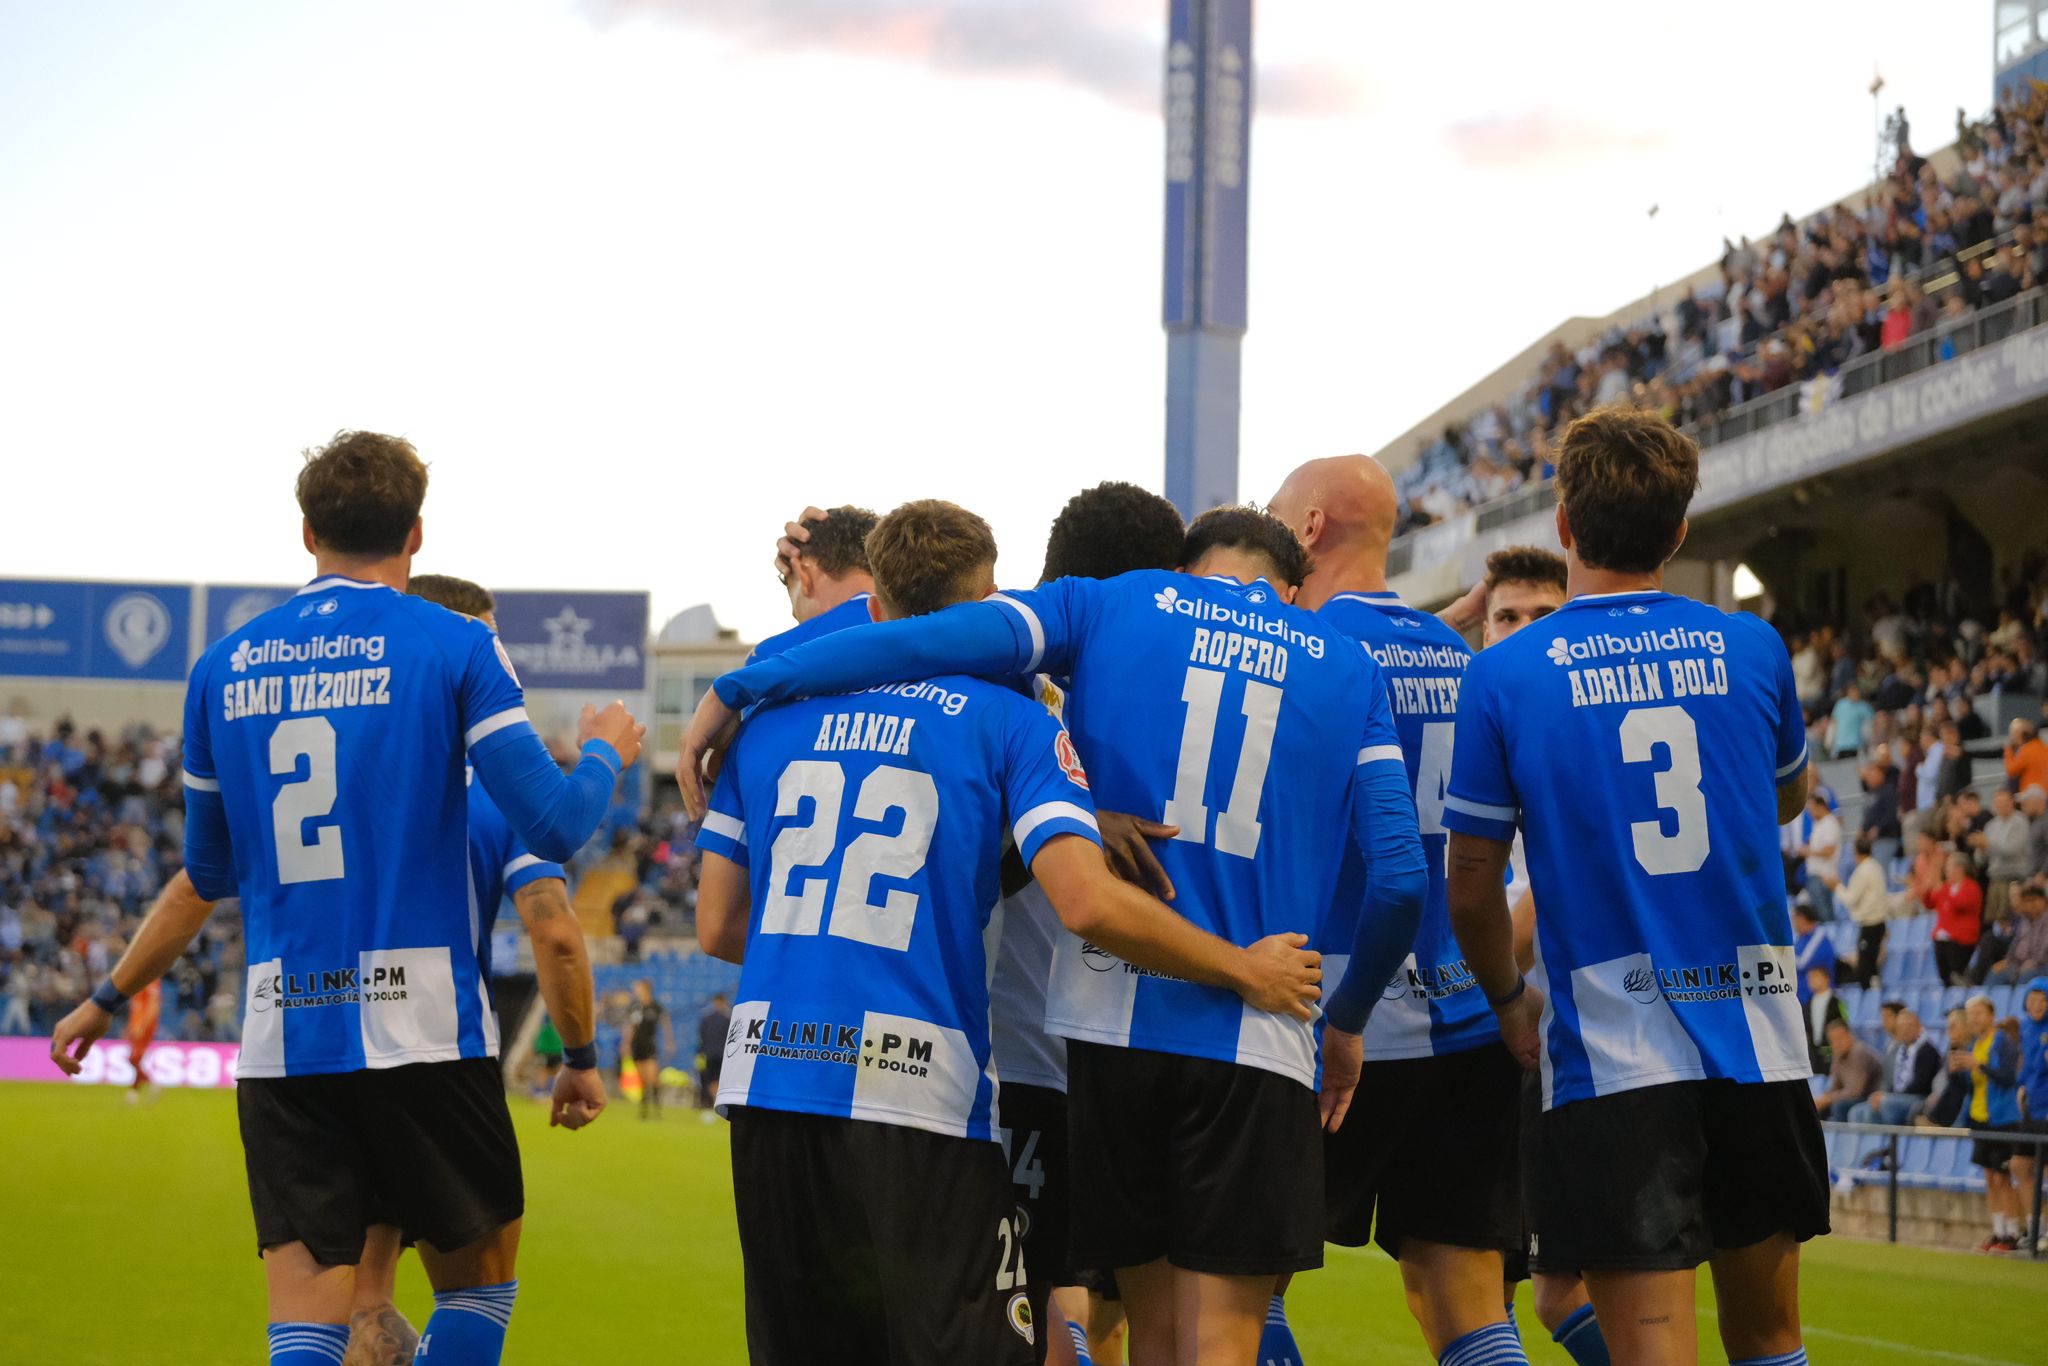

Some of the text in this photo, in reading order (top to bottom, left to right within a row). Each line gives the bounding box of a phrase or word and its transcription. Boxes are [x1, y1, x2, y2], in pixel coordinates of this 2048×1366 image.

[247, 634, 385, 666] alibuilding
[1175, 598, 1325, 660] alibuilding
[1189, 627, 1288, 683] ROPERO
[1569, 627, 1726, 660] alibuilding
[223, 666, 391, 722] SAMU VÁZQUEZ
[1391, 677, 1462, 714] RENTER
[1567, 656, 1729, 708] ADRIÁN BOLO
[813, 712, 916, 756] ARANDA
[1163, 666, 1283, 860] 11
[268, 716, 345, 885] 2
[1618, 705, 1711, 875] 3
[760, 760, 939, 952] 22
[364, 992, 372, 1003] Y
[1745, 986, 1754, 996] Y
[1759, 983, 1793, 996] DOLO
[744, 1043, 928, 1078] TRAUMATOLOGÍA Y DOLOR
